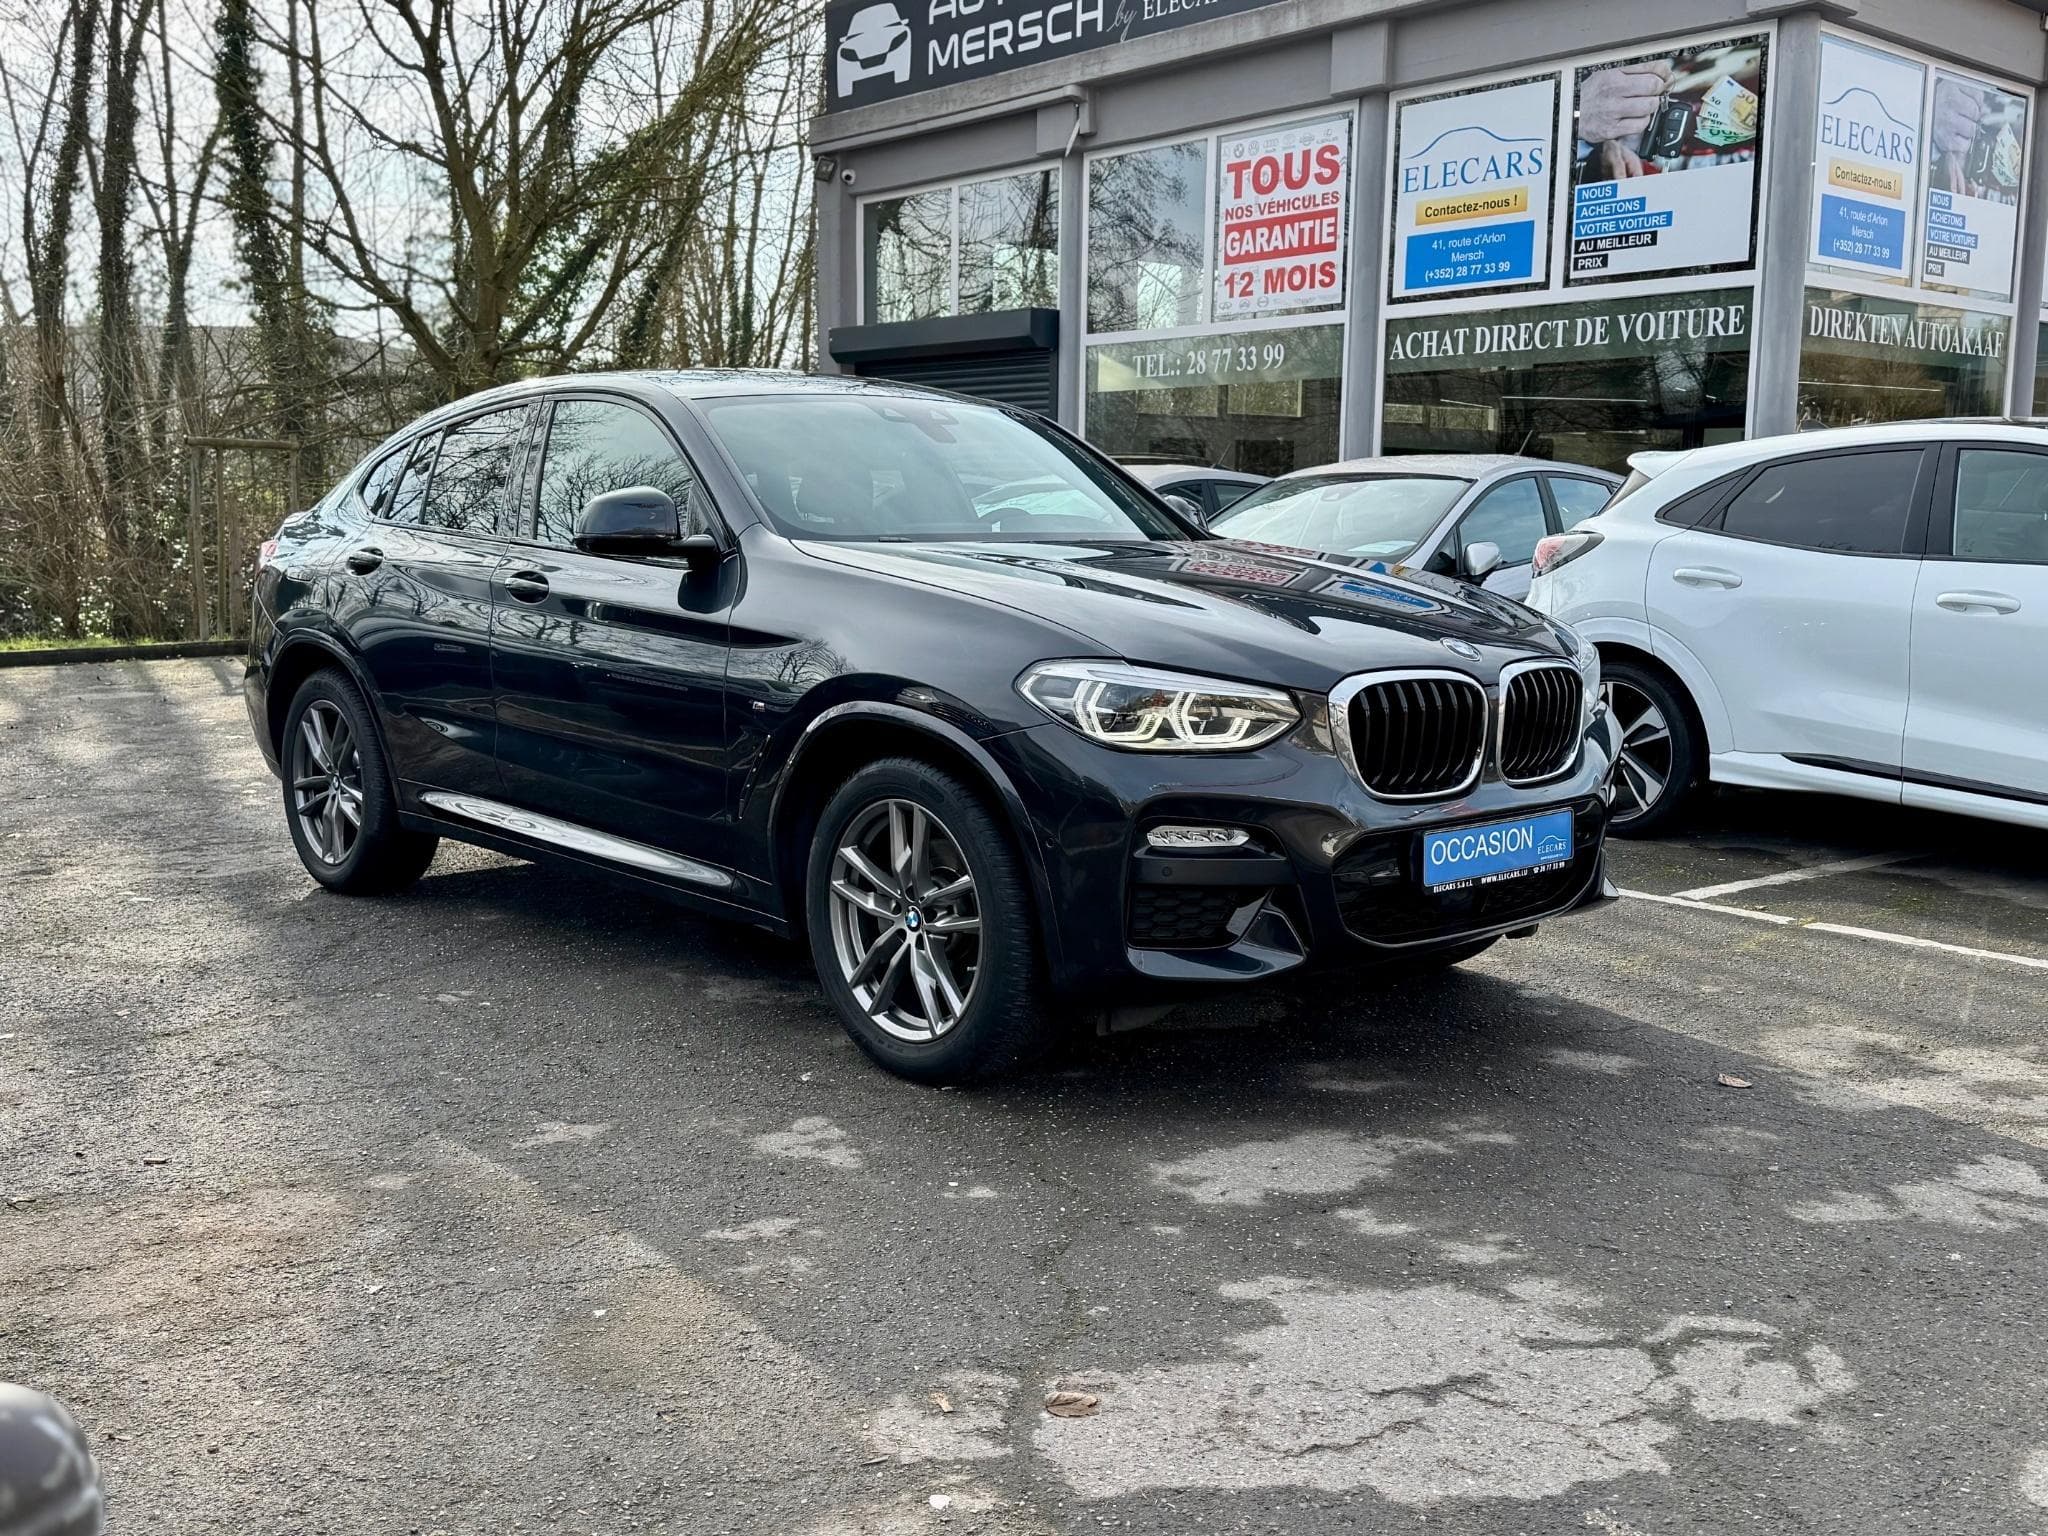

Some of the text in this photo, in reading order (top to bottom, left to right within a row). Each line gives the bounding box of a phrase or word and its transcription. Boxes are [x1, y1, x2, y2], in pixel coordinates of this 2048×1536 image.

[1107, 0, 1138, 41] by
[929, 0, 1103, 75] MERSCH
[1821, 113, 1913, 164] ELECARS
[1226, 144, 1341, 200] TOUS
[1403, 147, 1543, 193] ELECARS
[1835, 166, 1892, 190] Contactez-nous
[1582, 186, 1612, 200] NOUS
[1931, 192, 1949, 206] NOUS
[1224, 190, 1340, 221] NOS VÉHICULES
[1424, 194, 1518, 218] Contactez-nous !
[1580, 200, 1640, 218] ACHETONS
[1850, 210, 1866, 222] route
[1580, 214, 1668, 235] VOTRE VOITURE
[1930, 212, 1963, 227] ACHETONS
[1226, 217, 1336, 257] GARANTIE
[1432, 231, 1506, 251] 41, route d'Arlon
[1578, 233, 1652, 252] AU MEILLEUR
[1852, 225, 1874, 239] Mersch
[1930, 228, 1976, 247] VOTRE VOITURE
[1452, 250, 1485, 263] Mersch
[1833, 238, 1890, 259] (+352) 28 77 33 99
[1929, 245, 1968, 261] AU MEILLEUR
[1425, 261, 1511, 282] (+352) 28 77 33 99
[1578, 257, 1603, 269] PRIX
[1928, 262, 1942, 275] PRIX
[1224, 261, 1336, 298] 12 MOIS
[1390, 305, 1746, 361] ACHAT DIRECT DE VOITURE
[1809, 305, 2005, 358] DIREKTEN AUTOAKAAF
[1132, 343, 1285, 378] TEL.: 28 77 33 99
[1431, 826, 1533, 865] OCCASION
[1537, 842, 1567, 855] ELECARS
[1433, 882, 1456, 893] ELECARS
